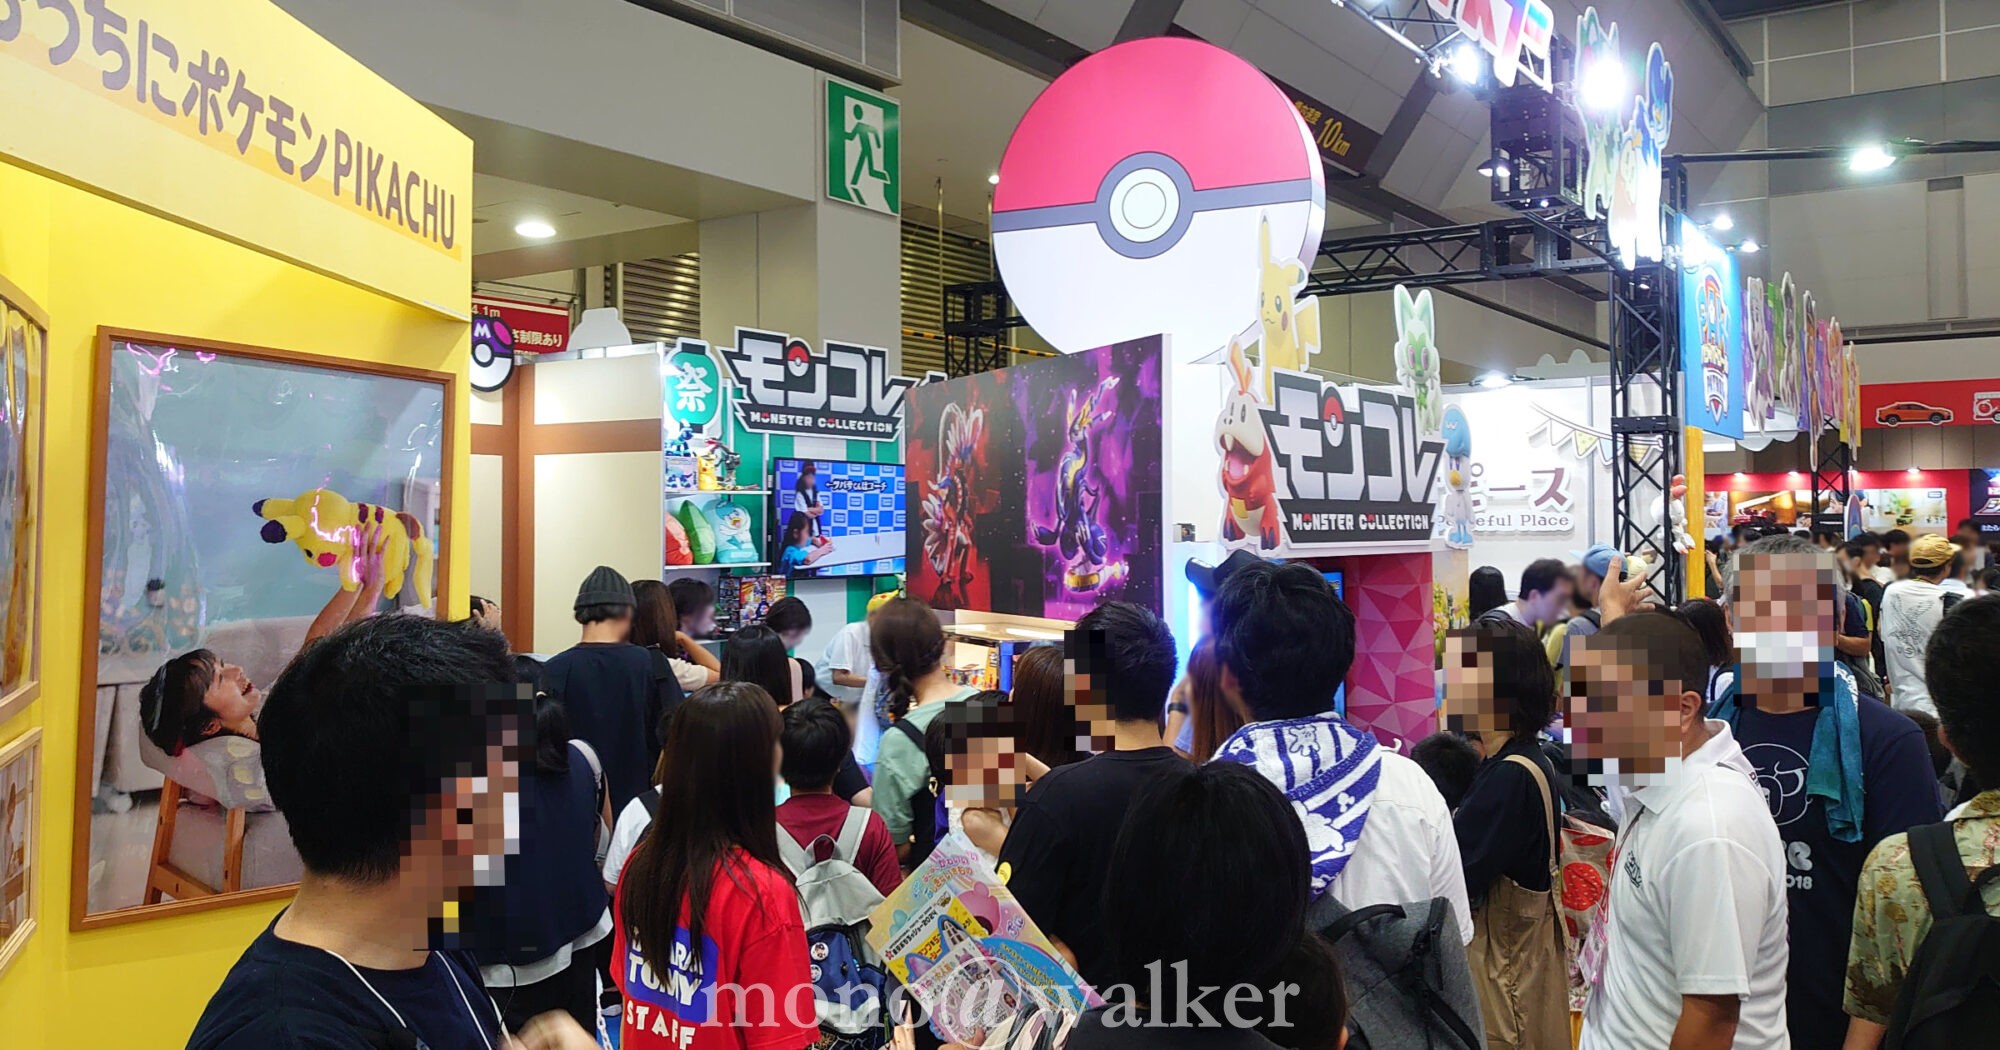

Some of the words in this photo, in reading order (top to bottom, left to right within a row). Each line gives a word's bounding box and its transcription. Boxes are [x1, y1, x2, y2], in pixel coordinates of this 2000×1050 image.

[333, 128, 456, 250] PIKACHU
[674, 361, 713, 413] 祭
[732, 337, 907, 416] モンコレ
[750, 410, 813, 428] MONSTER
[817, 416, 893, 433] COLLECTION
[1269, 386, 1438, 503] モンコレ
[1291, 513, 1355, 531] MONSTER
[1358, 513, 1429, 531] COLLECTION
[1520, 514, 1570, 527] Place
[1785, 874, 1813, 890] 018
[629, 952, 703, 1006] TOMY
[626, 999, 697, 1050] STAFF
